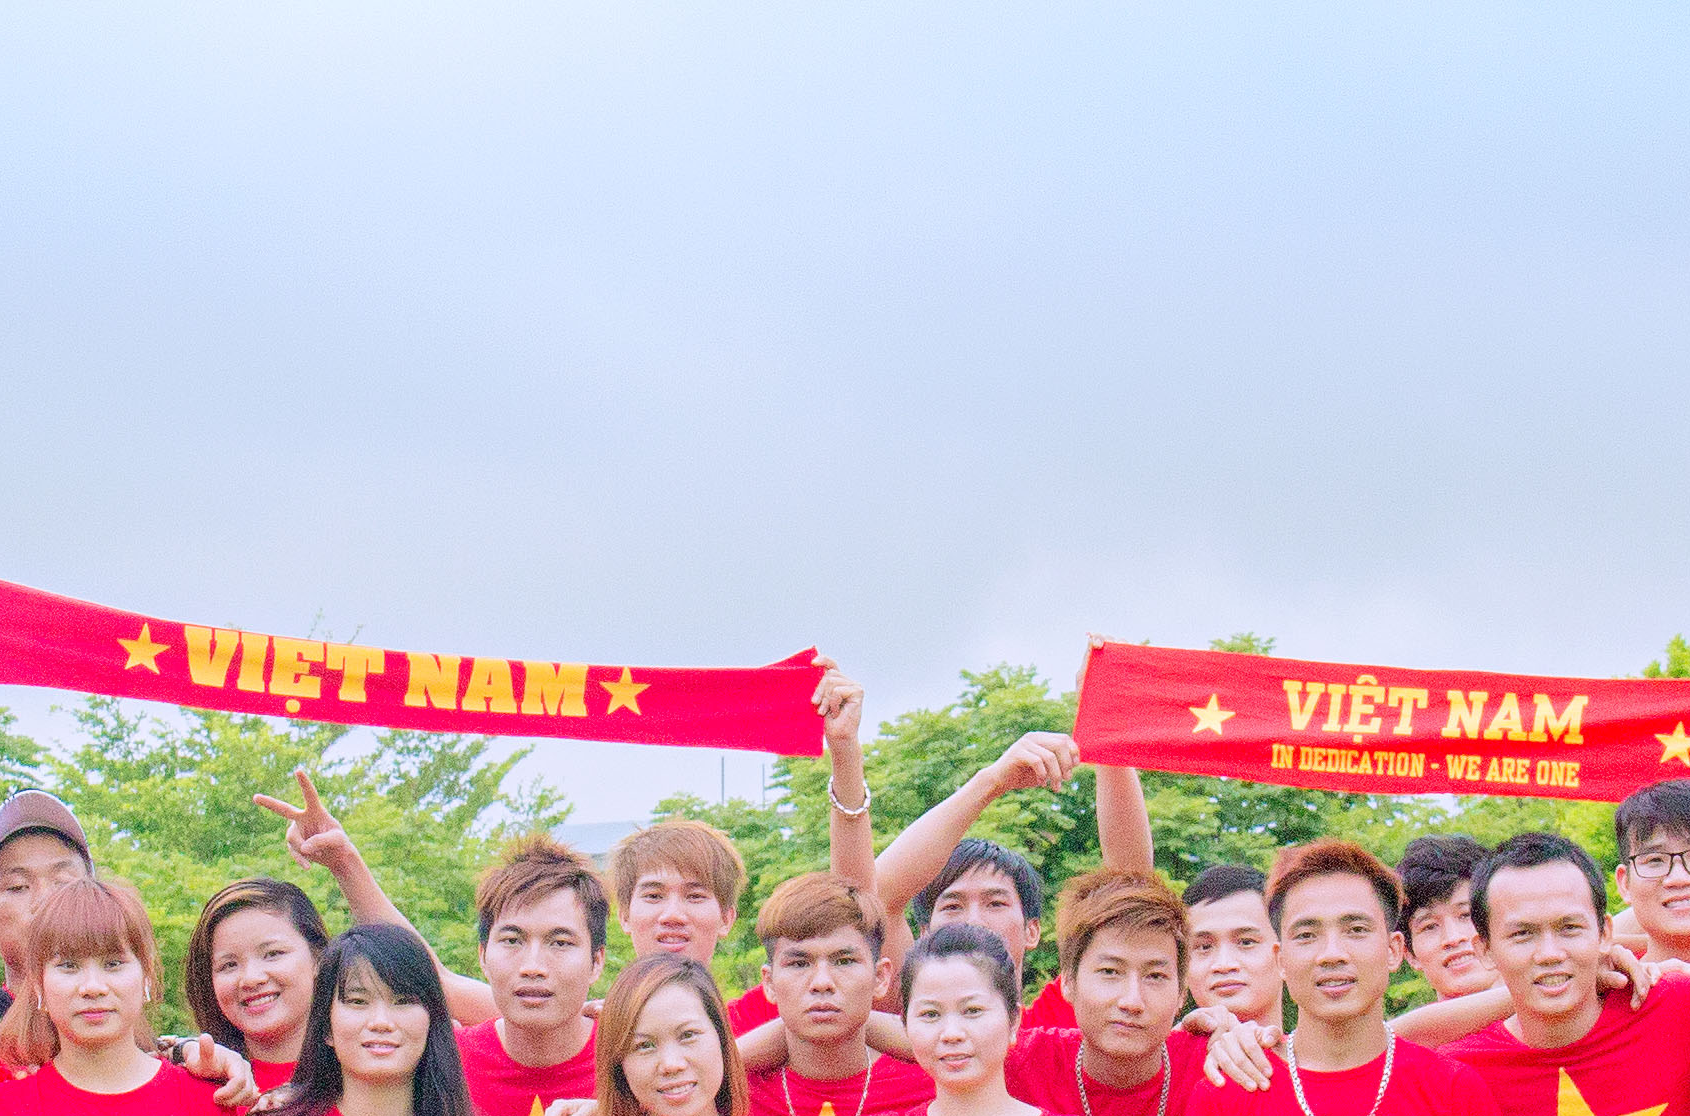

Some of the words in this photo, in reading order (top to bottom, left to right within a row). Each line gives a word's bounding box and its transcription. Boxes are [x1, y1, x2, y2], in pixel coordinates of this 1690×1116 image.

[404, 652, 589, 717] NAM
[1283, 675, 1428, 743] VIỆT
[1441, 690, 1588, 744] NAM
[1271, 744, 1294, 768] IN
[1299, 747, 1425, 777] DEDICATION
[1446, 755, 1481, 781] WE
[1485, 757, 1530, 784] ARE
[1536, 760, 1580, 787] ONE
